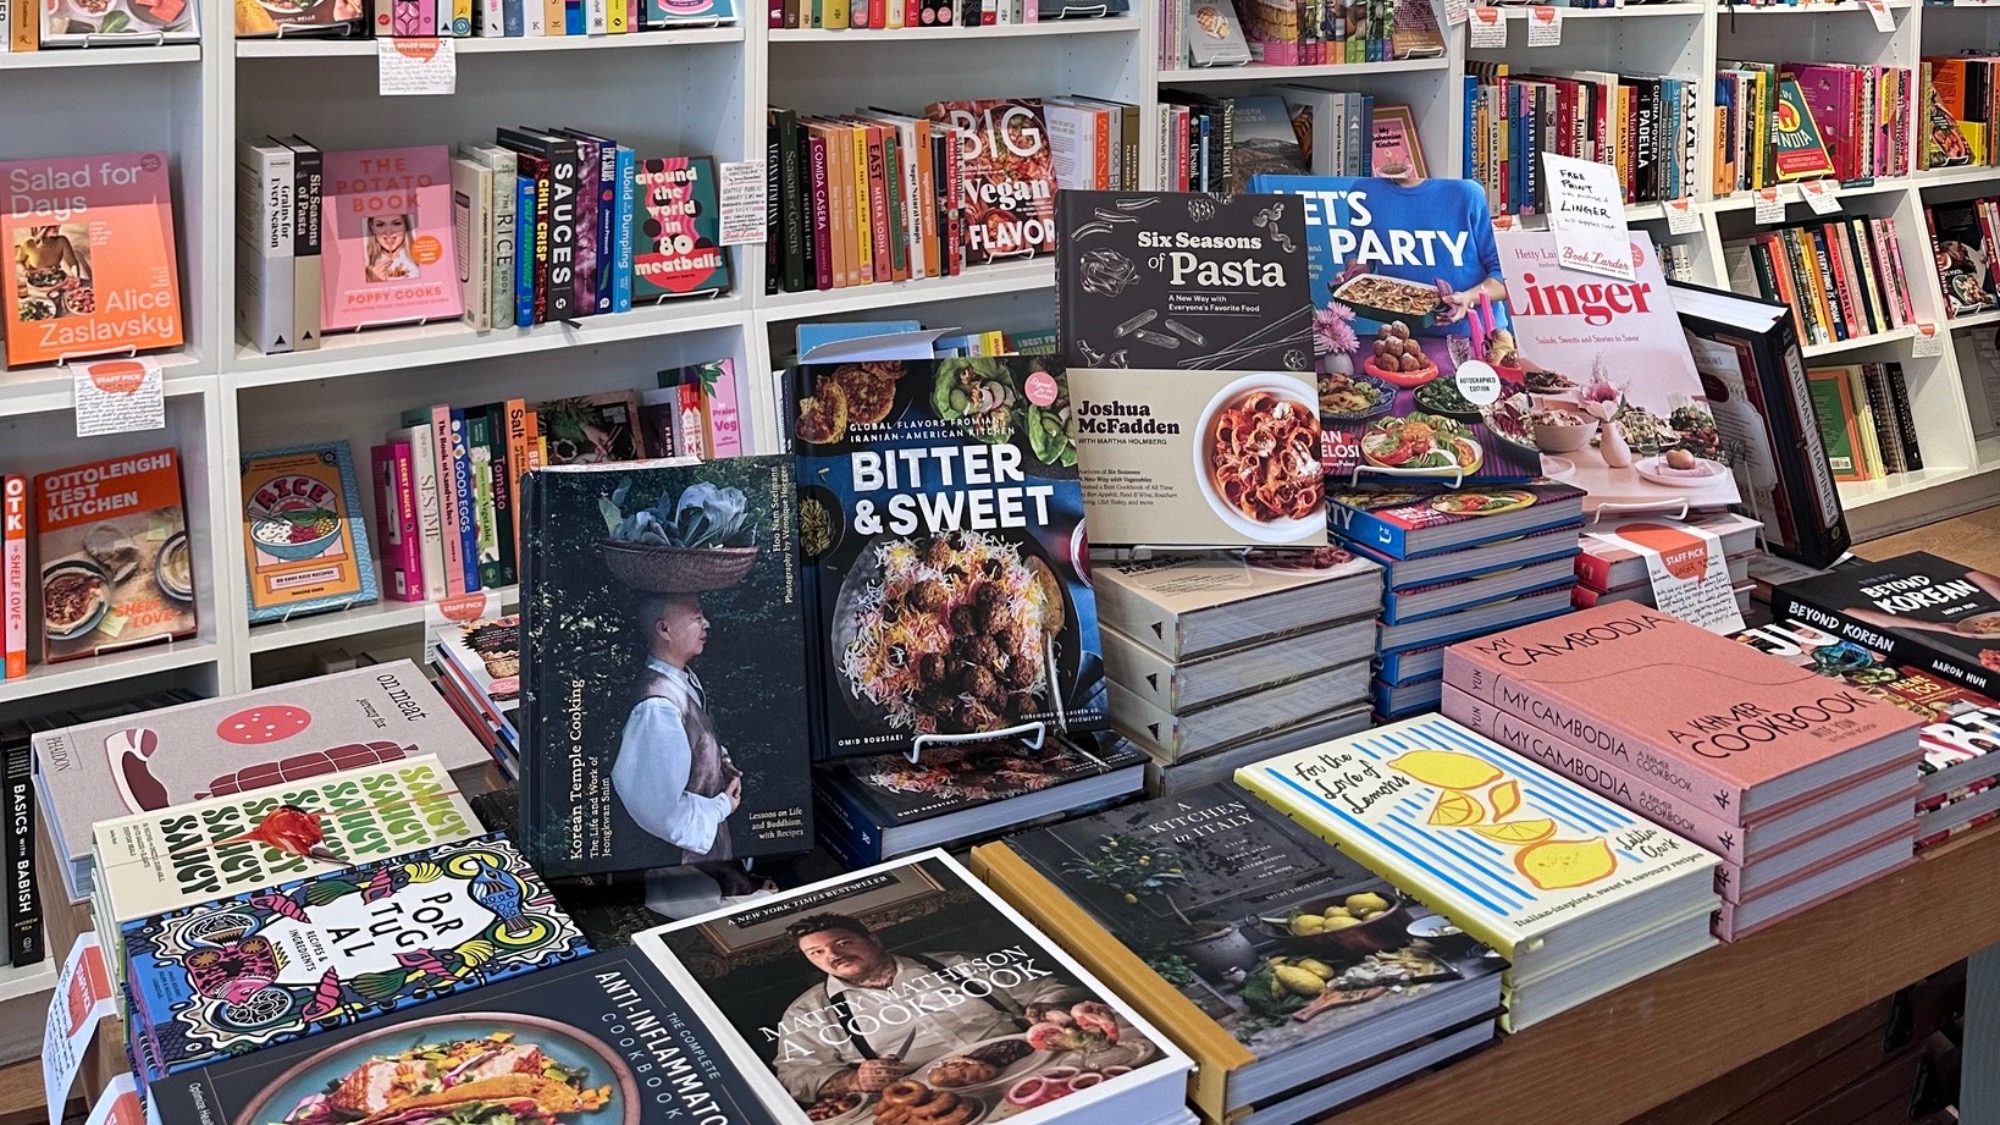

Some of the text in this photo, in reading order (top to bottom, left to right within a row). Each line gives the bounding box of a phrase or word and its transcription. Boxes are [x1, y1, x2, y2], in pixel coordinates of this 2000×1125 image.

[952, 107, 1041, 160] BIG
[1222, 104, 1234, 178] Samarkand
[1638, 109, 1651, 169] PADELLA
[1651, 85, 1660, 161] CUCINA POVERA
[10, 162, 142, 193] Salad for
[336, 174, 433, 194] POTATO
[360, 158, 406, 173] THE
[635, 167, 697, 185] around
[1559, 169, 1586, 181] FREE
[353, 195, 420, 212] BOOK
[655, 187, 682, 199] the
[814, 144, 826, 230] COMIDA CASERA
[869, 144, 886, 255] EAST MEERA SODHA
[963, 178, 1050, 210] Vegan
[1560, 180, 1593, 193] PRINT
[12, 195, 87, 221] Days
[309, 174, 320, 246] Six Seasons
[537, 179, 549, 261] CHILI CRISP
[552, 164, 573, 284] SAUCES
[618, 166, 633, 270] World Dumpling
[647, 200, 696, 218] world
[665, 219, 682, 233] in
[1561, 200, 1611, 219] LINGER
[660, 235, 693, 256] 80
[969, 218, 1055, 250] FLAVOR
[1138, 231, 1262, 249] Six Seasons
[1328, 228, 1469, 267] PARTY
[1857, 229, 1870, 268] AMRIKAN
[634, 254, 722, 275] meatballs
[1148, 253, 1166, 273] of
[1169, 252, 1287, 287] Pasta
[1515, 248, 1557, 261] Hetty Lui
[1563, 246, 1629, 271] Book Larder
[105, 289, 171, 313] Alice
[348, 287, 441, 304] POPPY COOKS
[1504, 273, 1652, 326] Linger
[1838, 280, 1853, 324] MASALA
[39, 313, 174, 347] Zaslavsky
[511, 408, 525, 439] Salt
[714, 419, 737, 433] Veg
[850, 418, 979, 432] GLOBAL FLAVORS FROM
[1078, 400, 1150, 416] Joshua
[1078, 418, 1180, 434] McFadden
[850, 427, 1016, 443] IRANIAN-AMERICAN KITCHEN
[1321, 444, 1360, 458] ELOSI
[1790, 358, 1835, 517] TALISMAN HAPPINESS
[44, 454, 171, 492] OTTOLENGHI
[493, 455, 507, 510] Tomato
[851, 443, 1024, 492] BITTER
[46, 482, 100, 506] TEST
[48, 491, 139, 522] KITCHEN
[255, 478, 328, 511] RICE
[399, 458, 411, 519] SECRET SAUCES
[455, 461, 470, 533] GOOD EGGS
[421, 475, 440, 544] SESAME
[854, 485, 1054, 536] & SWEET
[7, 479, 23, 620] OTK SHELF LOVE
[1665, 547, 1706, 567] STAFF PICK
[1860, 574, 1931, 599] BEYOND
[1873, 579, 1980, 615] KOREAN
[115, 600, 161, 617] SHELF
[134, 608, 173, 628] LOVE
[1788, 601, 1895, 652] BEYOND KOREAN
[1474, 637, 1516, 654] MY
[1498, 614, 1677, 667] CAMBODIA
[1932, 659, 1987, 689] AARON HUH
[376, 674, 429, 721] on meat
[1473, 669, 1630, 762] YUN MY CAMBODIA
[838, 734, 904, 746] OMID ROUSTAEI
[1667, 702, 1771, 744] A KHMER
[1692, 691, 1878, 760] COOKBOOK
[47, 735, 72, 772] PHAIDON
[569, 679, 586, 860] Korean Temple Cooking
[1294, 753, 1352, 781] For the
[1472, 706, 1632, 801] YUN MY CAMBODIA
[1315, 759, 1381, 800] Love of
[1636, 758, 1693, 792] COOKBOOK
[13, 784, 28, 835] BASICS
[360, 773, 432, 845] SAUCY
[398, 766, 470, 837] SAUCY
[1177, 801, 1192, 812] A
[1342, 775, 1410, 814] Lemons
[322, 781, 392, 855] SAUCY
[601, 777, 612, 857] Jeongkwan Snim
[1149, 800, 1248, 834] KITCHEN
[1174, 813, 1255, 844] in ITALY
[1639, 798, 1696, 834] COOKBOOK
[160, 815, 222, 895] SAUCY
[202, 806, 265, 884] SAUCY
[1640, 837, 1680, 859] Clark
[17, 860, 32, 913] BABISH
[727, 875, 888, 927] A NEW YORK TIMES BESTSELLER
[1514, 852, 1705, 928] Italian-inspired, sweet & savoury recipes
[368, 902, 429, 948] TUG
[412, 892, 464, 936] POR
[288, 928, 317, 972] INGREDIENTS
[326, 927, 375, 958] AL
[758, 945, 1029, 1042] MATTY MATHESON
[783, 959, 1053, 1063] A COOKBOOK
[666, 1011, 721, 1080] THE COMPLETE
[602, 1013, 683, 1120] COOKBOOK
